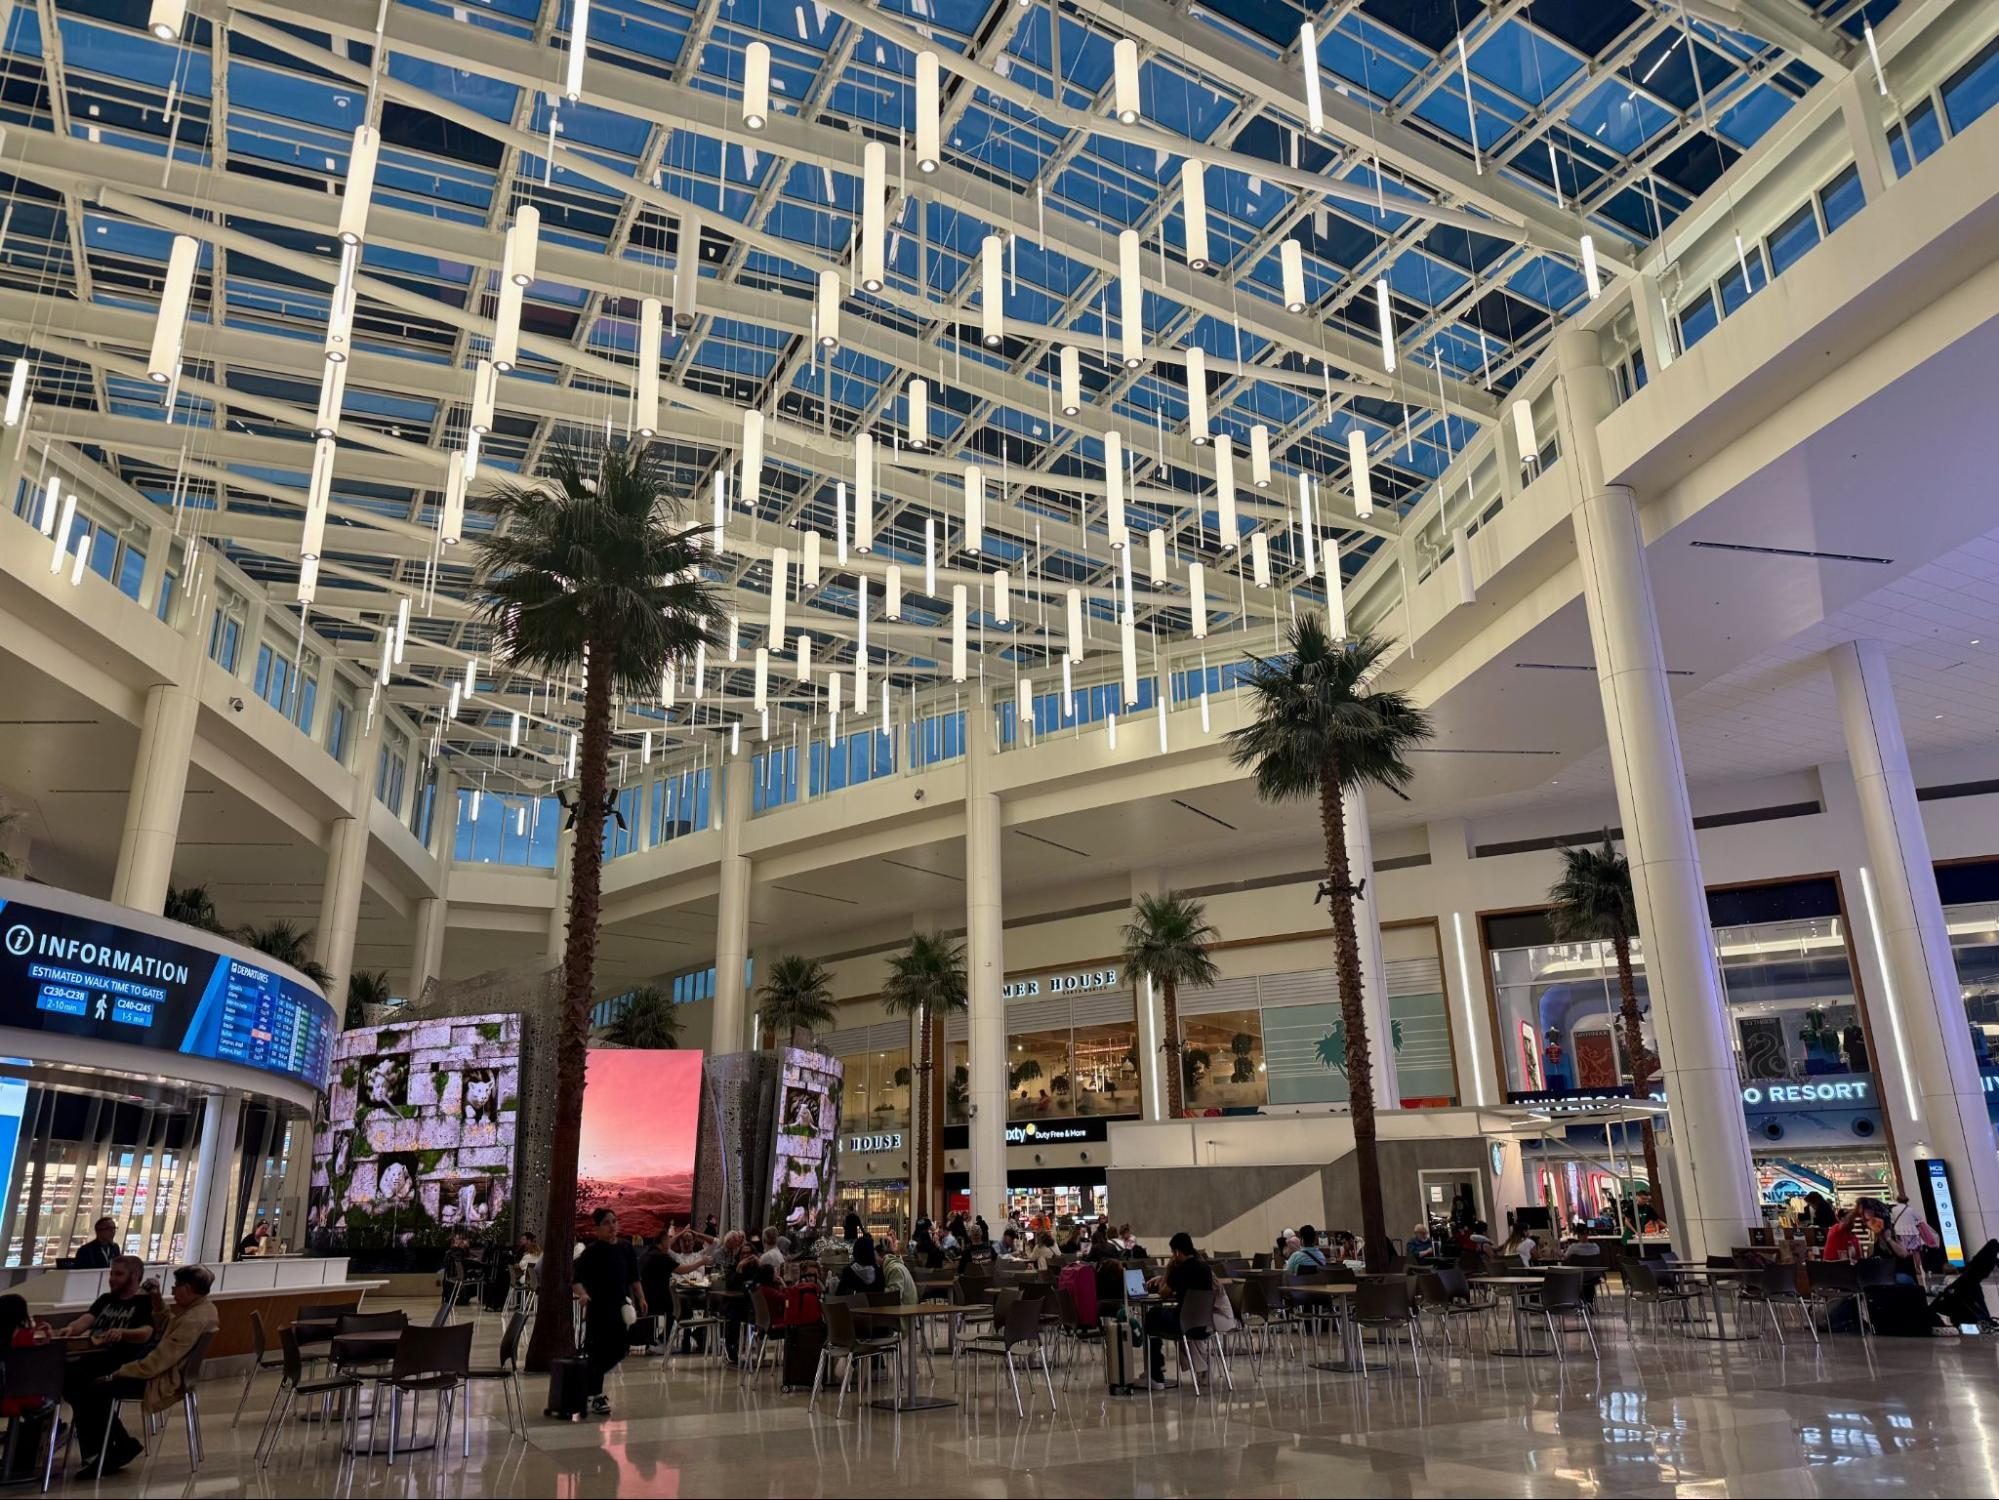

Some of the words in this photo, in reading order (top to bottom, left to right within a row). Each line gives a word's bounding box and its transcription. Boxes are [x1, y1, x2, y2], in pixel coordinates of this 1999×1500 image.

[38, 933, 189, 985] INFORMATION
[32, 966, 83, 983] ESTIMATED
[84, 976, 109, 989] WALK
[110, 981, 129, 993] TIME
[130, 985, 142, 995] TO
[142, 987, 164, 1000] GATES
[236, 965, 269, 984] DEPARTURES
[1050, 970, 1117, 992] HOUSE
[43, 986, 85, 1001] C230-C238
[1769, 1082, 1867, 1102] RESORT
[850, 1134, 901, 1151] HOUSE
[1035, 1131, 1050, 1140] Duty
[1050, 1130, 1065, 1138] Free
[1065, 1129, 1070, 1137] &
[1070, 1129, 1087, 1137] More
